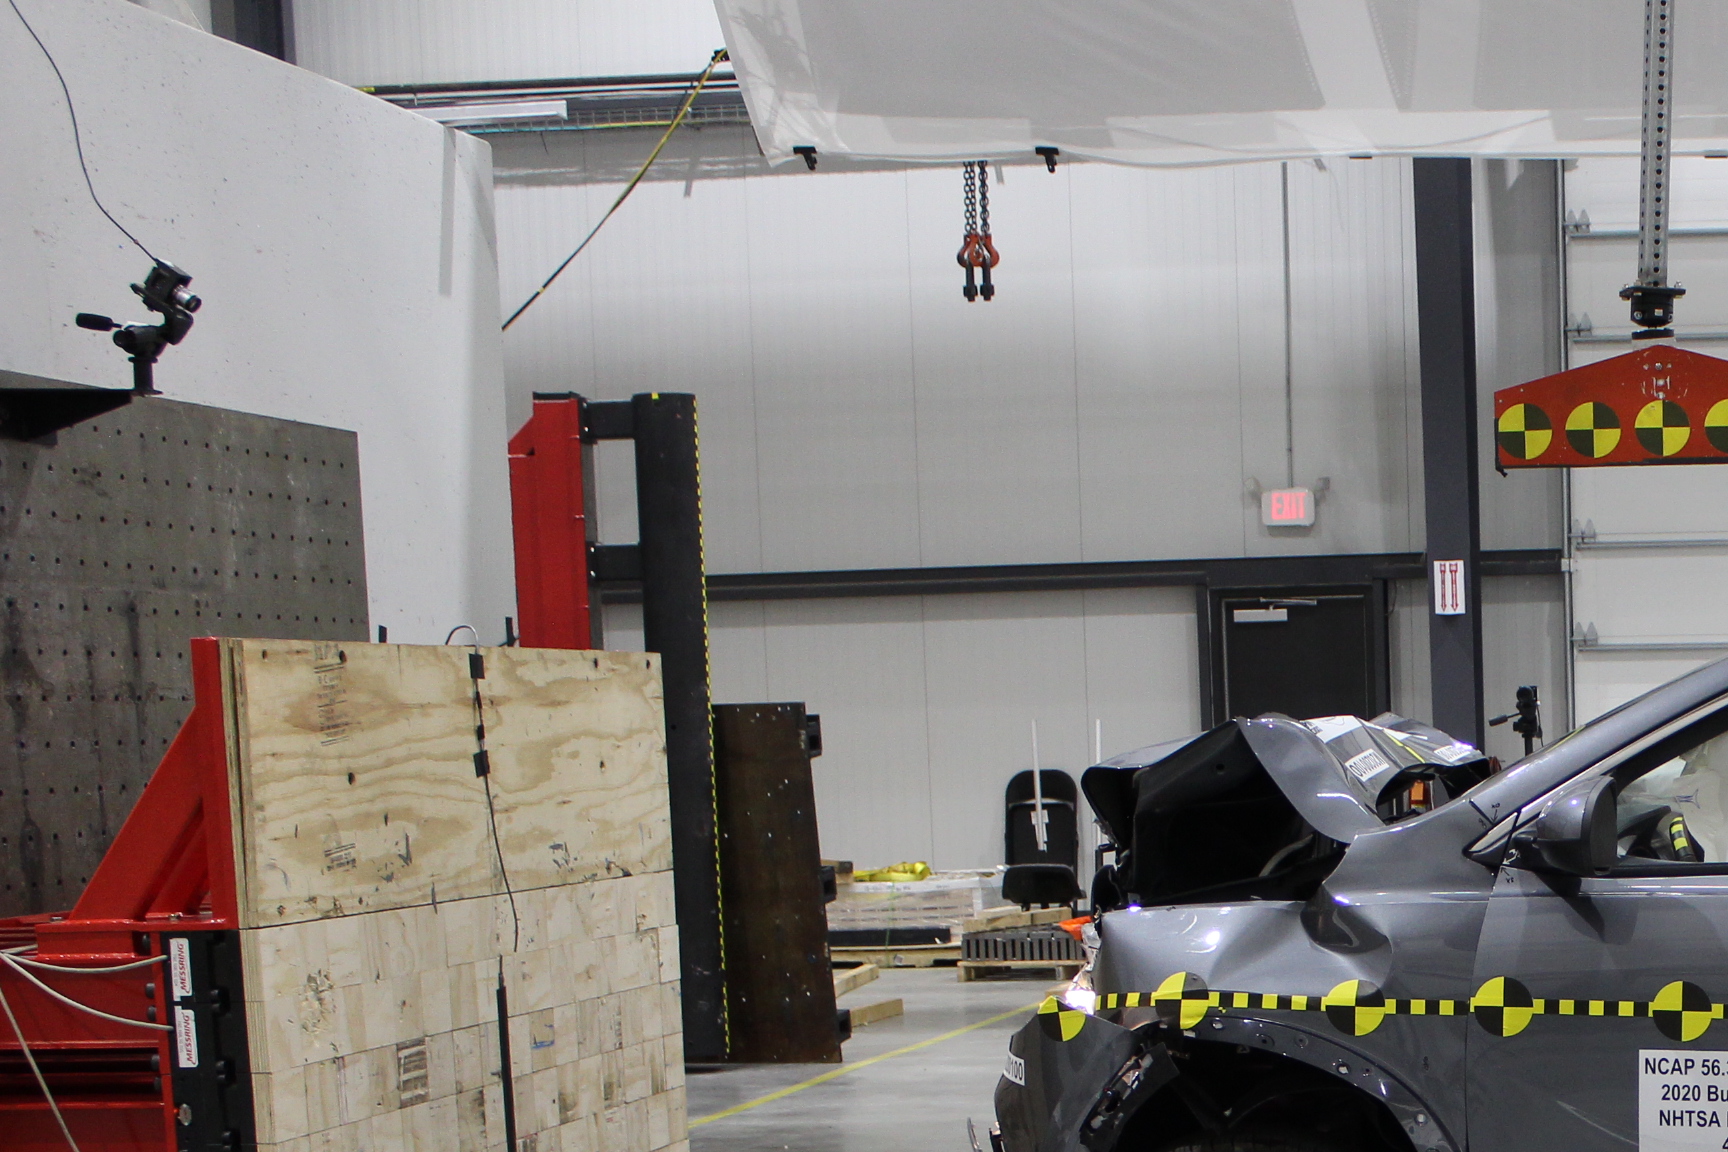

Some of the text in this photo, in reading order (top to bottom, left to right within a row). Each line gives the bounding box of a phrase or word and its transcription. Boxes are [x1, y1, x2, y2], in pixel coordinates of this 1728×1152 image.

[1271, 492, 1307, 520] EXIT
[177, 943, 188, 991] MESSRING
[183, 1015, 195, 1062] MESSRING
[1644, 1057, 1696, 1075] NCAP
[1661, 1084, 1701, 1101] 2020
[1659, 1110, 1721, 1127] NHTSA
